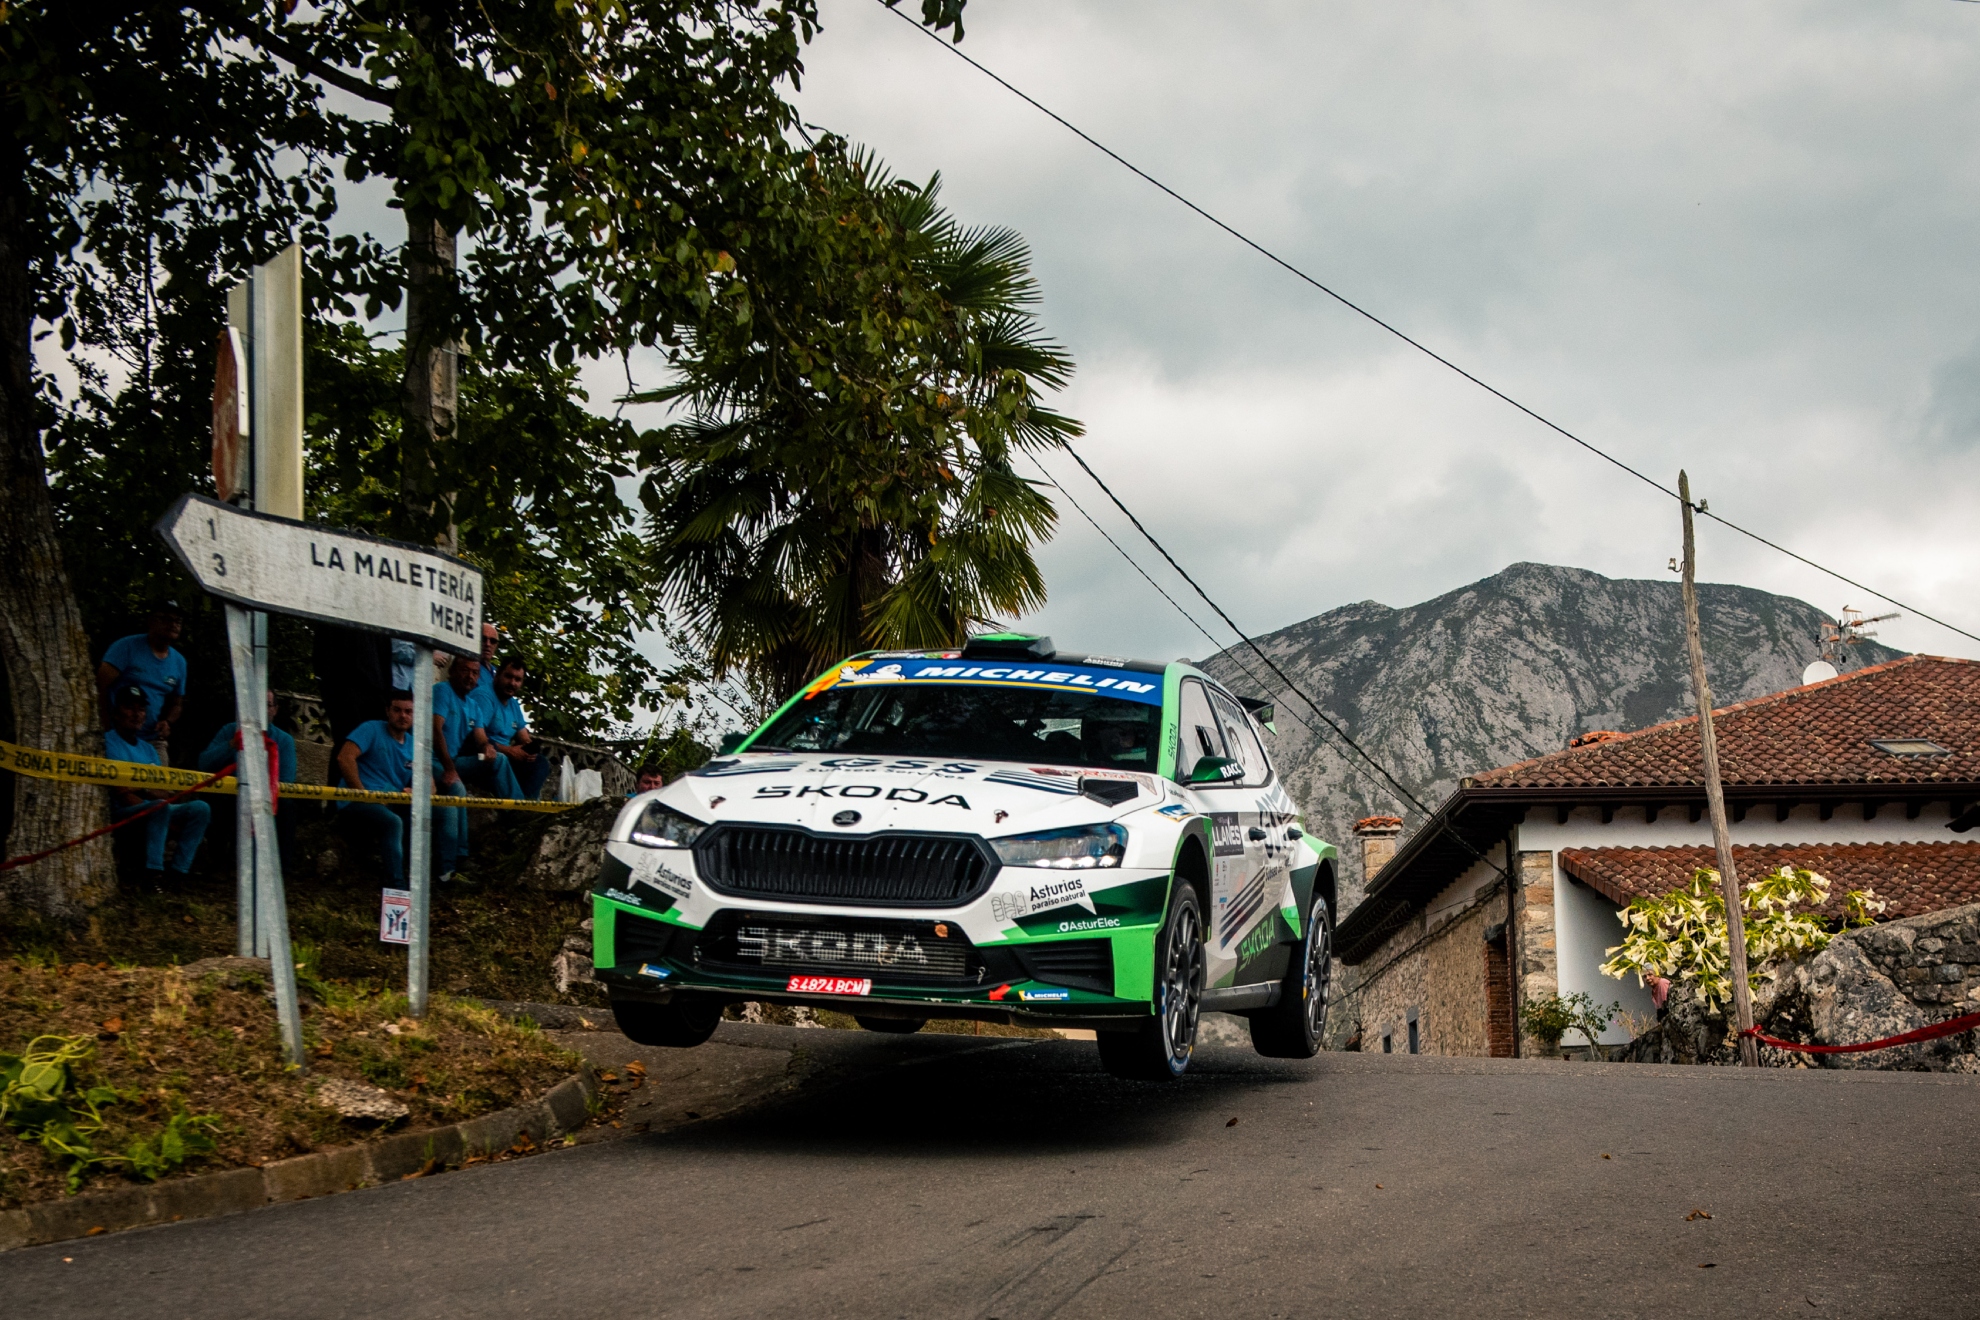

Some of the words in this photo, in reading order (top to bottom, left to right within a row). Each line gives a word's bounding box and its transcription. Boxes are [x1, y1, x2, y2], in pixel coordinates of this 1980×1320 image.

[207, 518, 216, 541] 1
[212, 553, 227, 577] 3
[310, 542, 345, 572] LA
[354, 551, 475, 606] MALETERÍA
[430, 602, 475, 640] MERÉ
[914, 667, 1156, 694] MICHELIN
[1168, 722, 1178, 760] SKODA
[15, 751, 52, 773] ZONA
[57, 758, 119, 780] PUBLICO
[130, 767, 166, 785] ZONA
[819, 757, 984, 774] GSS
[1220, 763, 1241, 778] RACC
[752, 785, 972, 810] SKODA
[1211, 824, 1241, 846] LLANES
[1030, 878, 1083, 902] Asturias
[1060, 889, 1086, 903] natural
[1069, 917, 1120, 931] AsturElec
[737, 927, 928, 965] SKODA
[1240, 914, 1276, 972] SKODA
[789, 977, 800, 990] S
[800, 978, 834, 992] 4874
[835, 979, 863, 993] BCM
